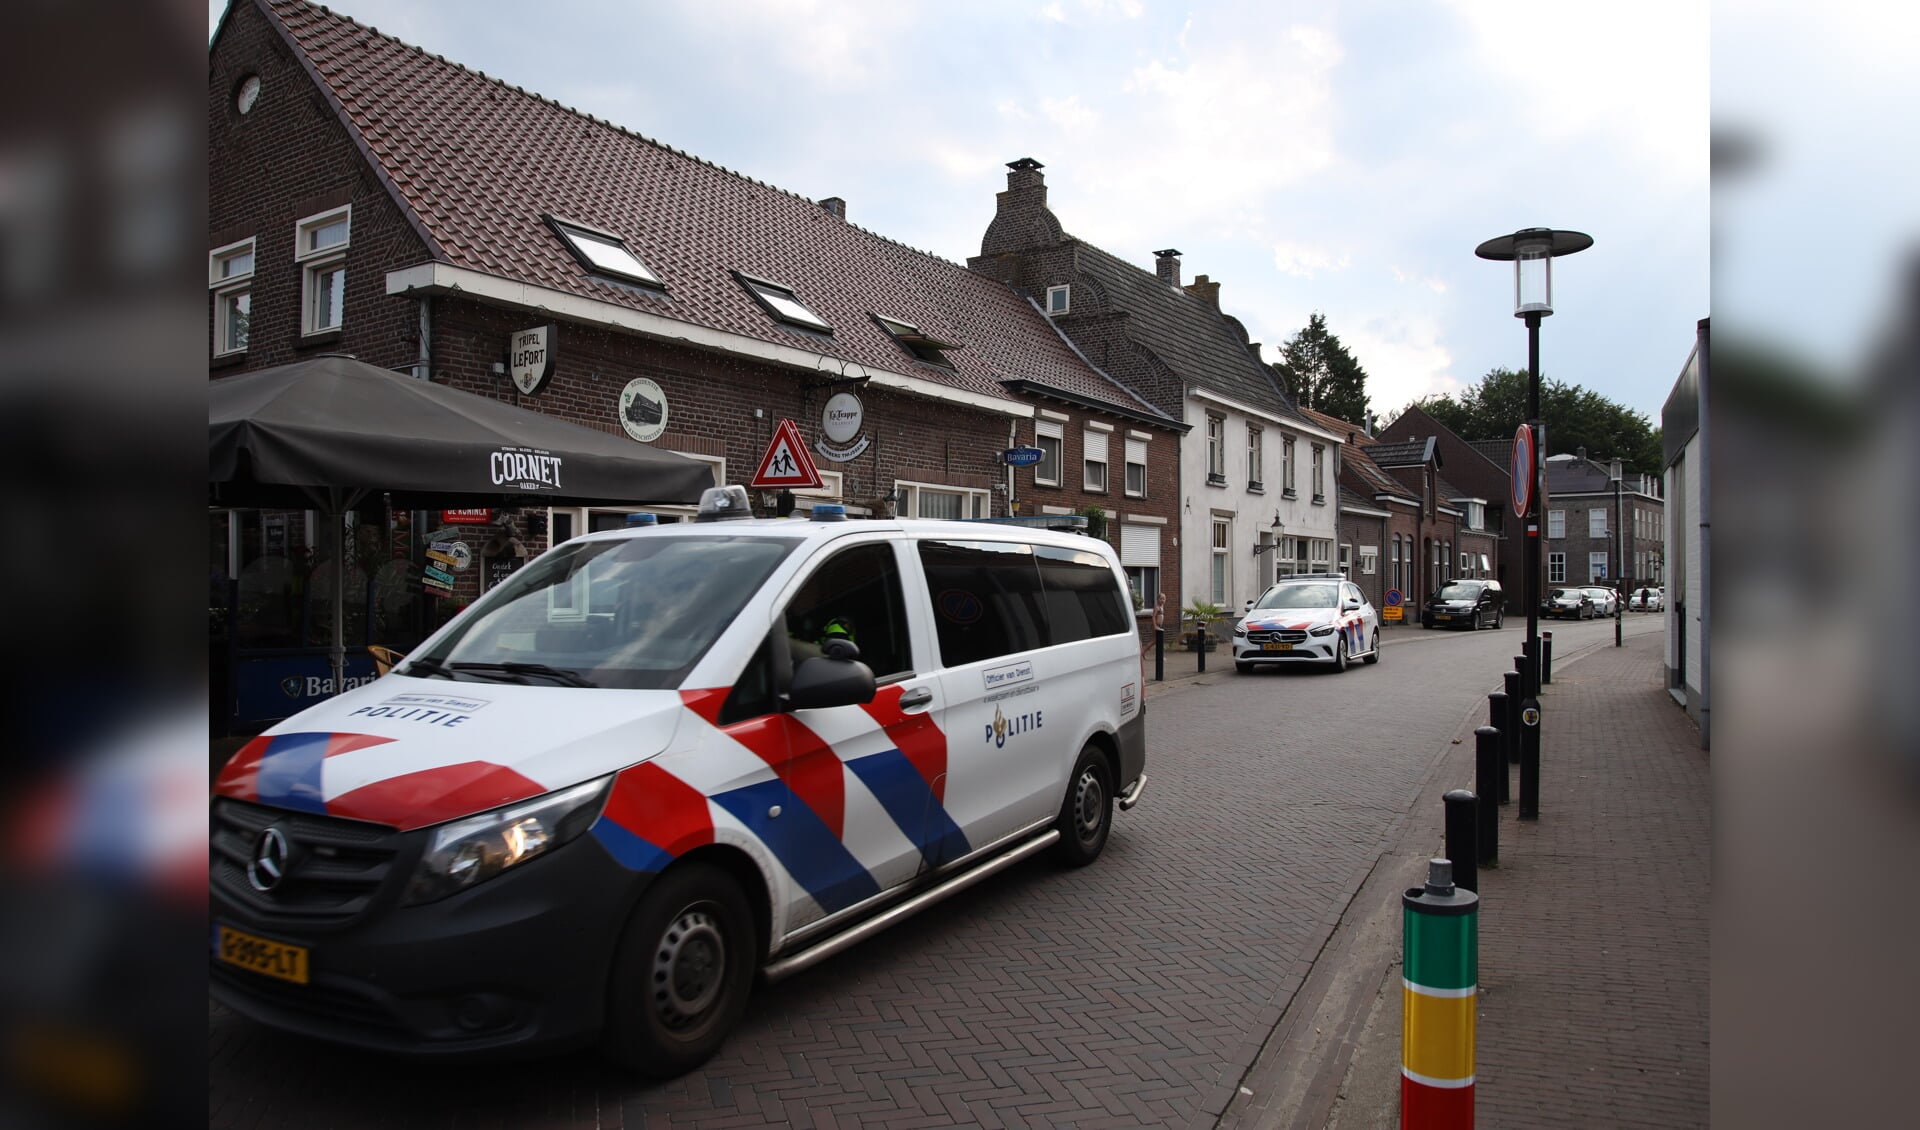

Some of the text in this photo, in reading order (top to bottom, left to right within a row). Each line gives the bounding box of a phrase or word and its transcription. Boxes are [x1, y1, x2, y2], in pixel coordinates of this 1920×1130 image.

[518, 333, 540, 349] TRIPEL
[820, 445, 841, 459] HERBERG
[1007, 452, 1038, 462] Bavaria
[490, 451, 562, 488] CORNET
[986, 667, 1031, 684] Officier van Dienst
[347, 706, 471, 728] POLITIE
[985, 711, 1042, 749] POLITIE
